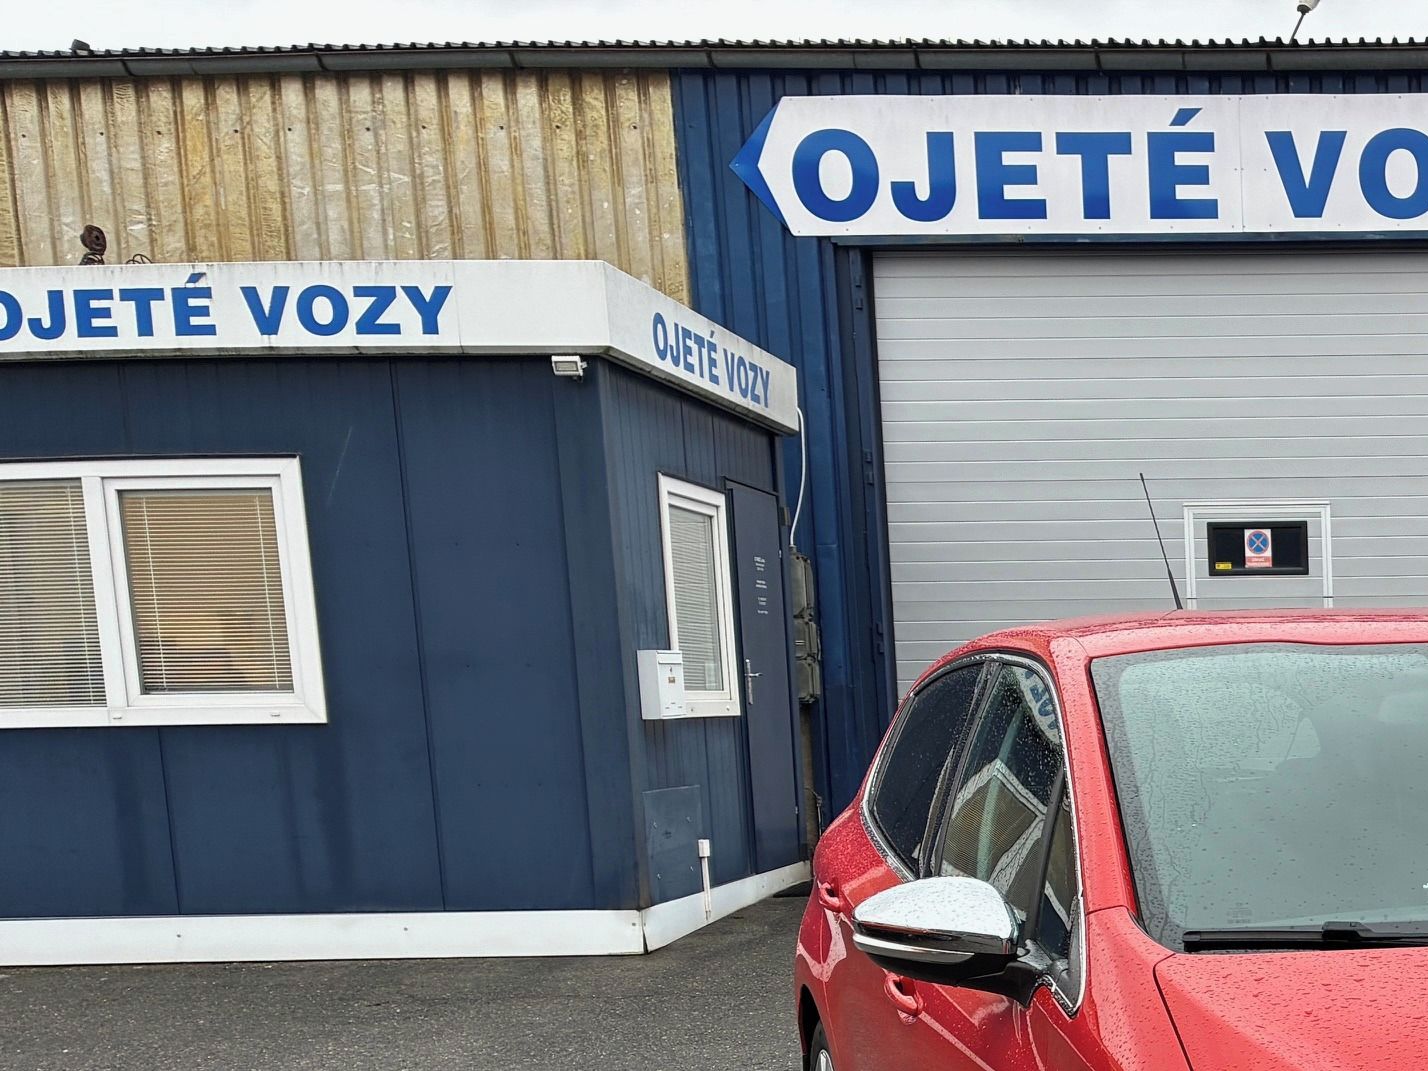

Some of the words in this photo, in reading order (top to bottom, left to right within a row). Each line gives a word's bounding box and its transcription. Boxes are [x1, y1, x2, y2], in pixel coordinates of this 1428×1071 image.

[793, 108, 1218, 222] OJETÉ
[241, 284, 452, 337] VOZY
[652, 312, 720, 386] OJETÉ
[722, 347, 770, 409] VOZY
